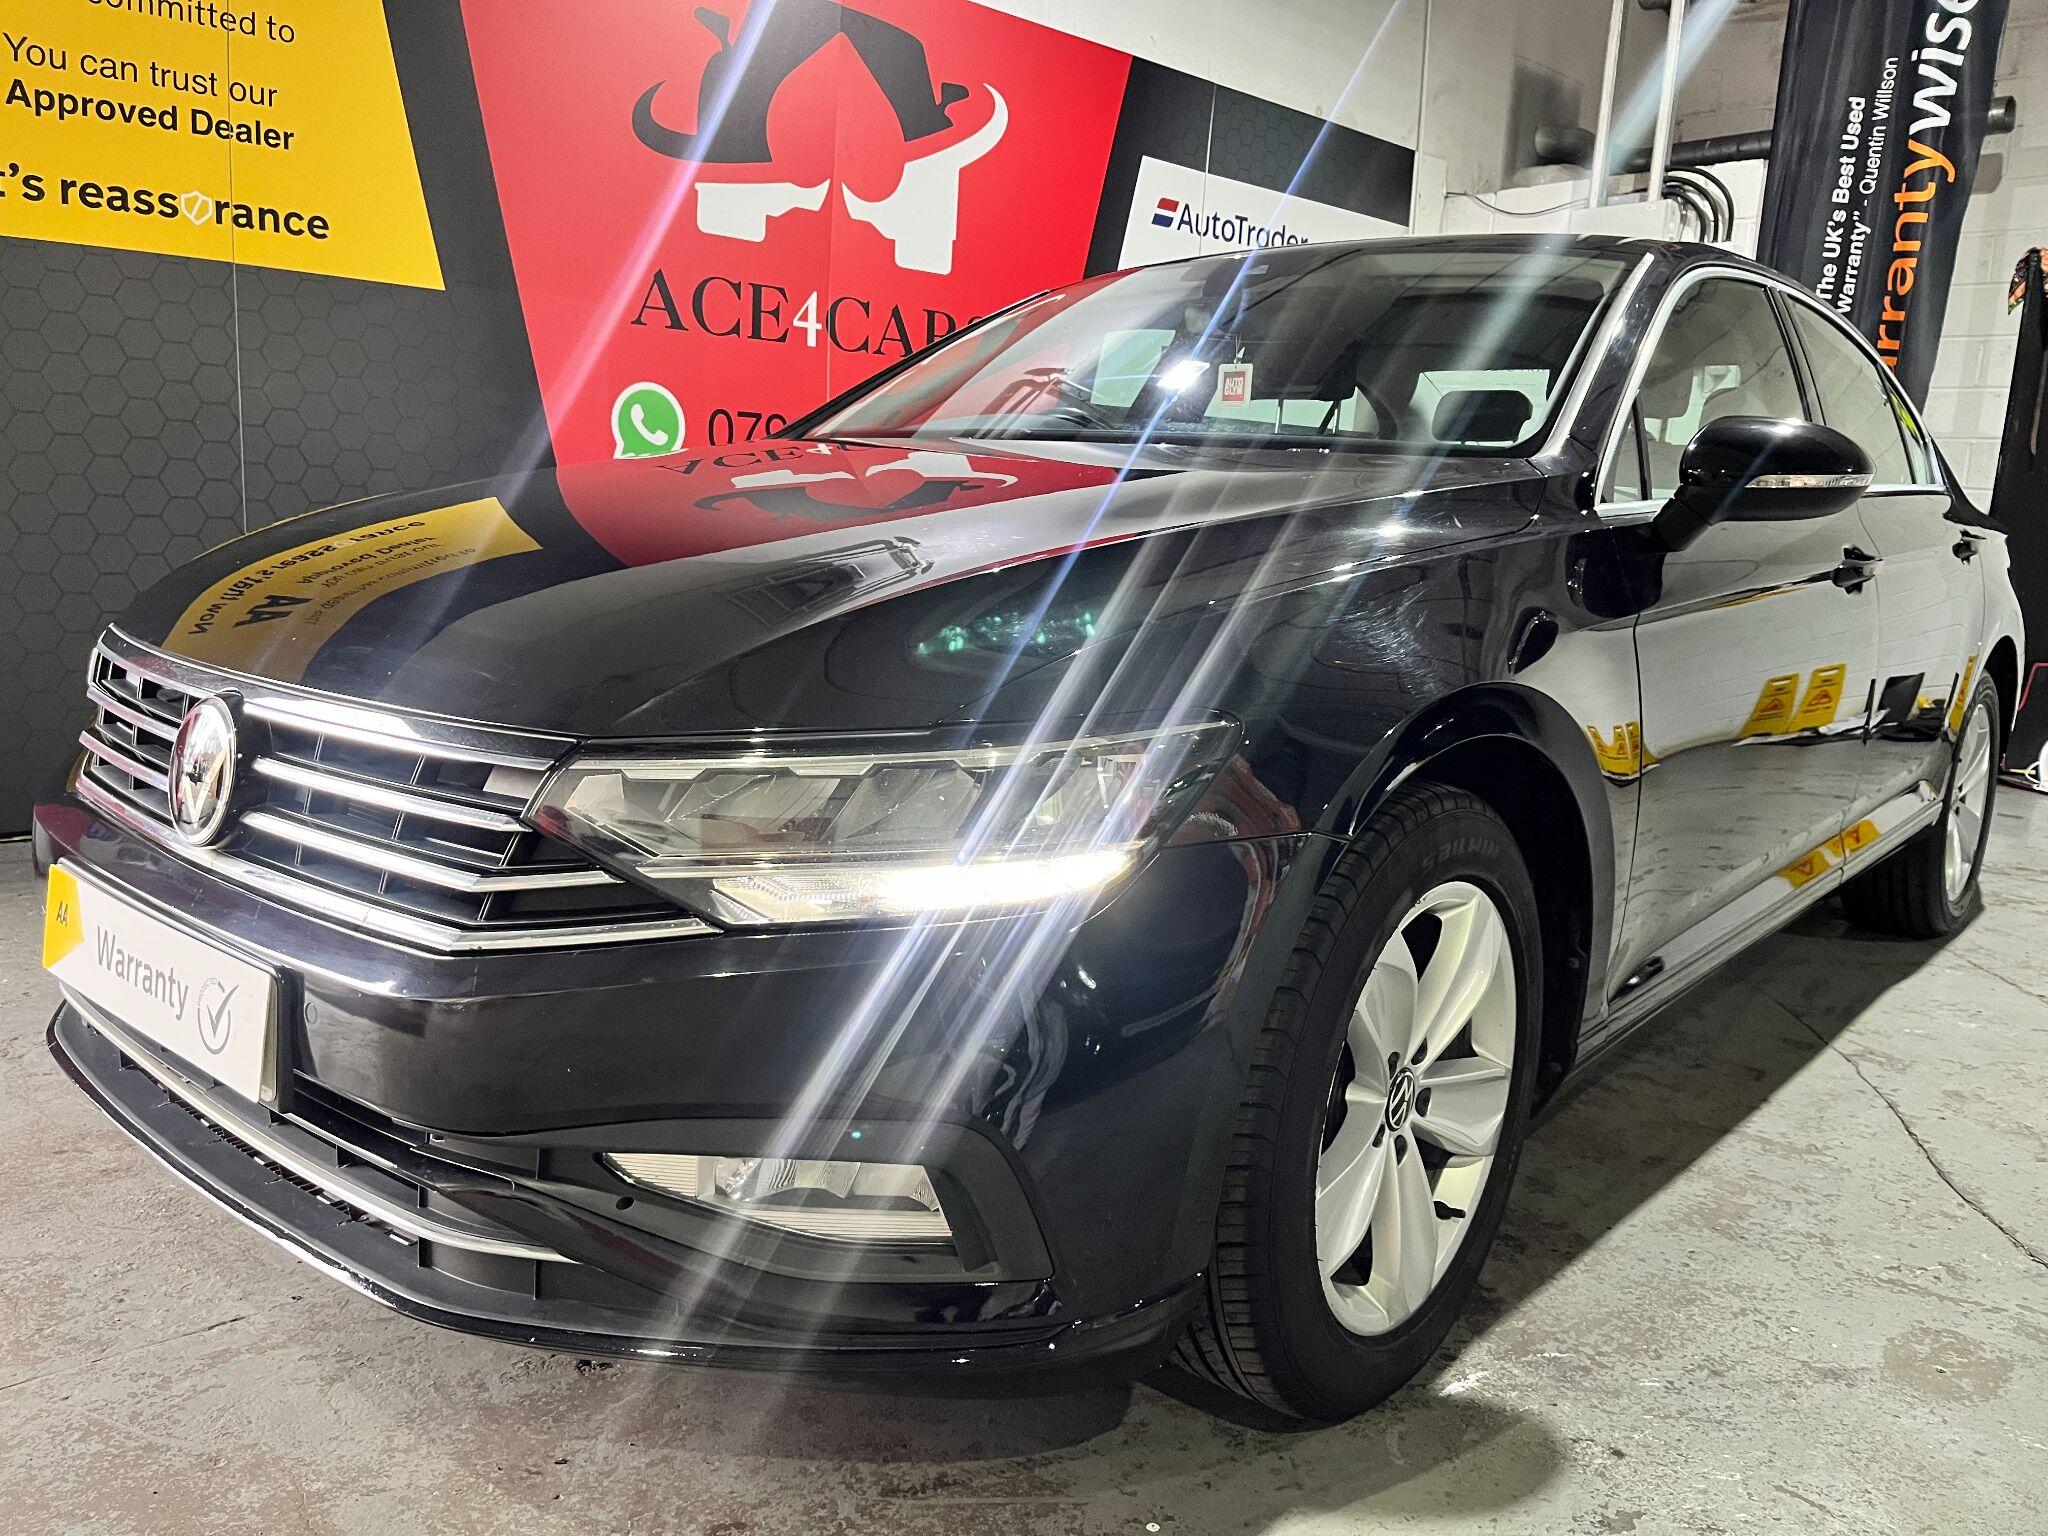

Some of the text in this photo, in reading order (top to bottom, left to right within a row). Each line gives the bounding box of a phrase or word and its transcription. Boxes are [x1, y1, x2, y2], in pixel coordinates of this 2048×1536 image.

[89, 0, 295, 43] mmitted to
[2, 32, 277, 107] You can trust our
[1872, 57, 1898, 121] Willson
[6, 79, 295, 150] Approved Dealer
[1859, 125, 1887, 195] Quentin
[1816, 96, 1866, 300] The UK's Best Used
[631, 268, 984, 357] ACE4CAR
[56, 900, 68, 927] AA
[97, 925, 189, 1021] Warranty
